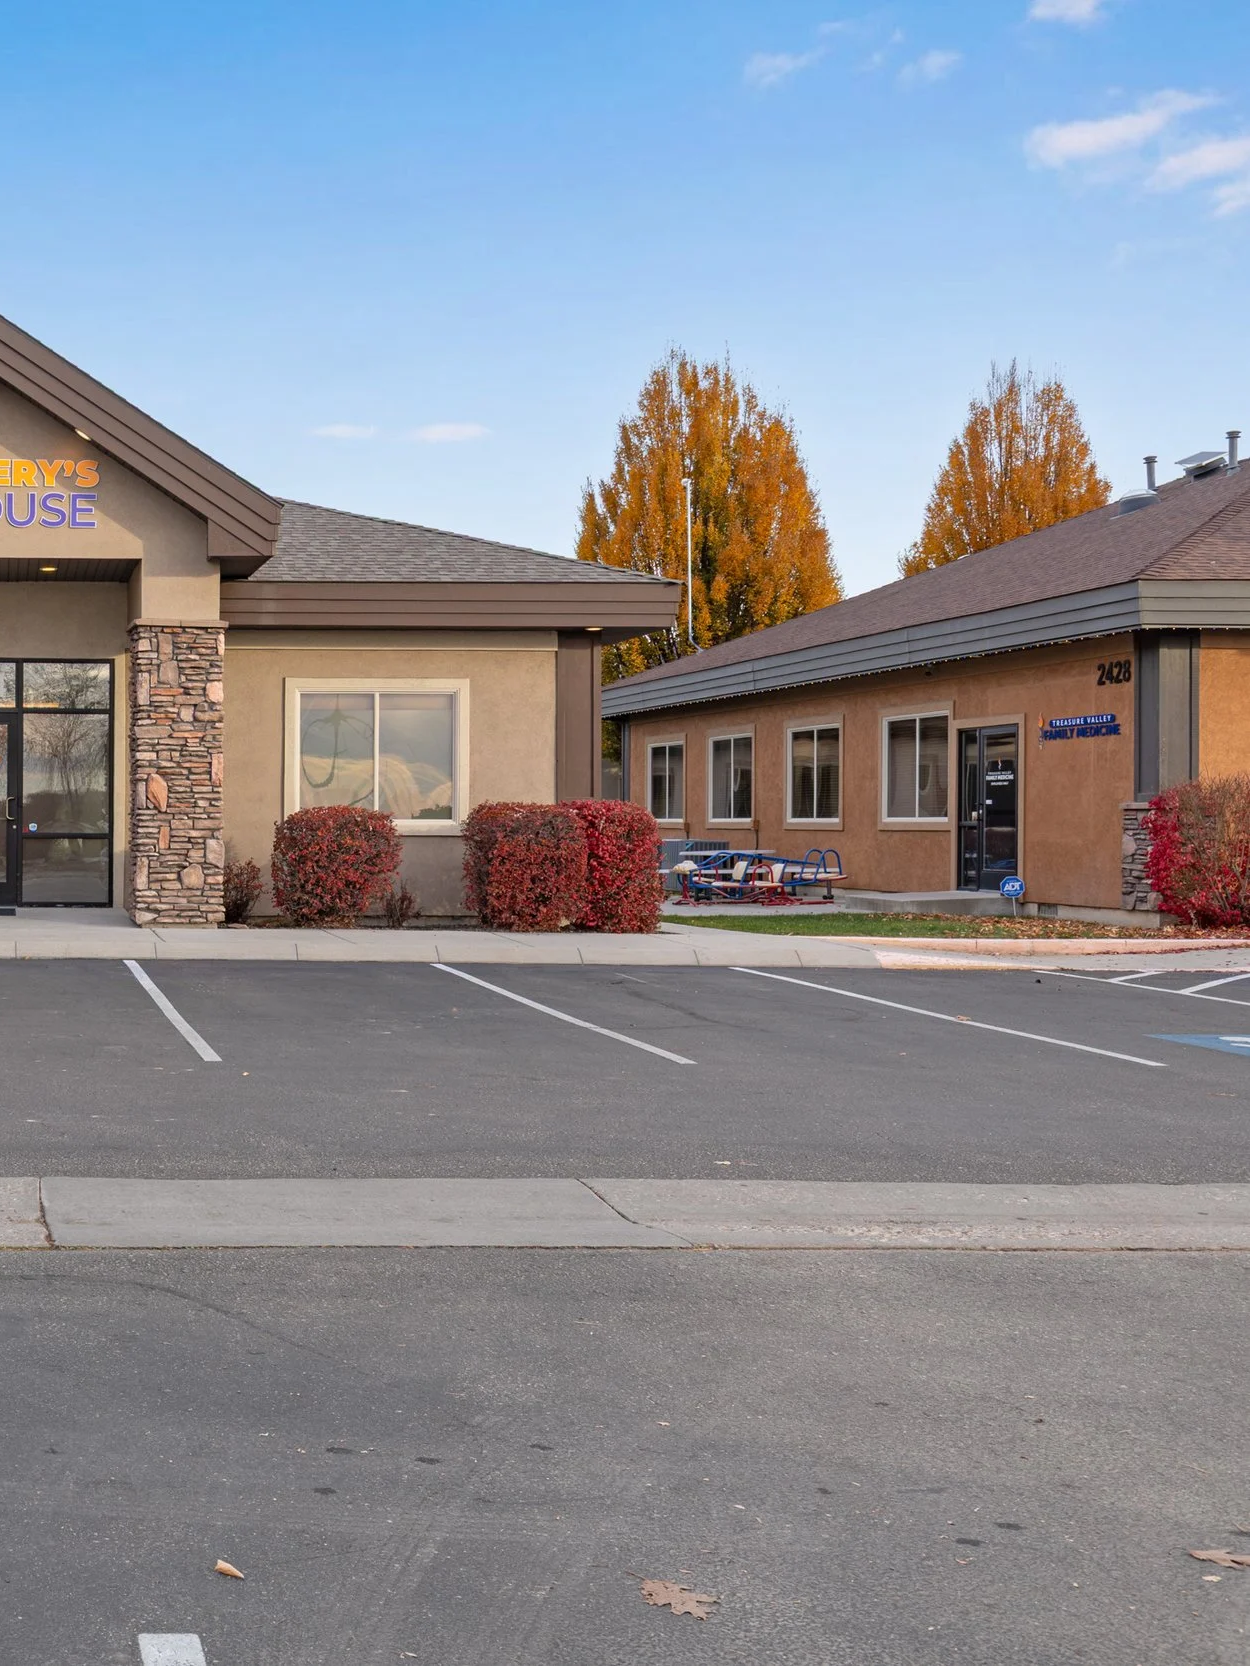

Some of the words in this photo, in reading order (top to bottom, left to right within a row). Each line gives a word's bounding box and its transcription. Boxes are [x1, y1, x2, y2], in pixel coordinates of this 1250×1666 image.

[1097, 660, 1132, 686] 2428
[1052, 717, 1085, 727] TREASURE
[1086, 715, 1112, 724] VALLEY
[1043, 728, 1075, 741] FAMILY
[1076, 723, 1121, 738] MEDICINE
[1003, 881, 1022, 891] ADT
